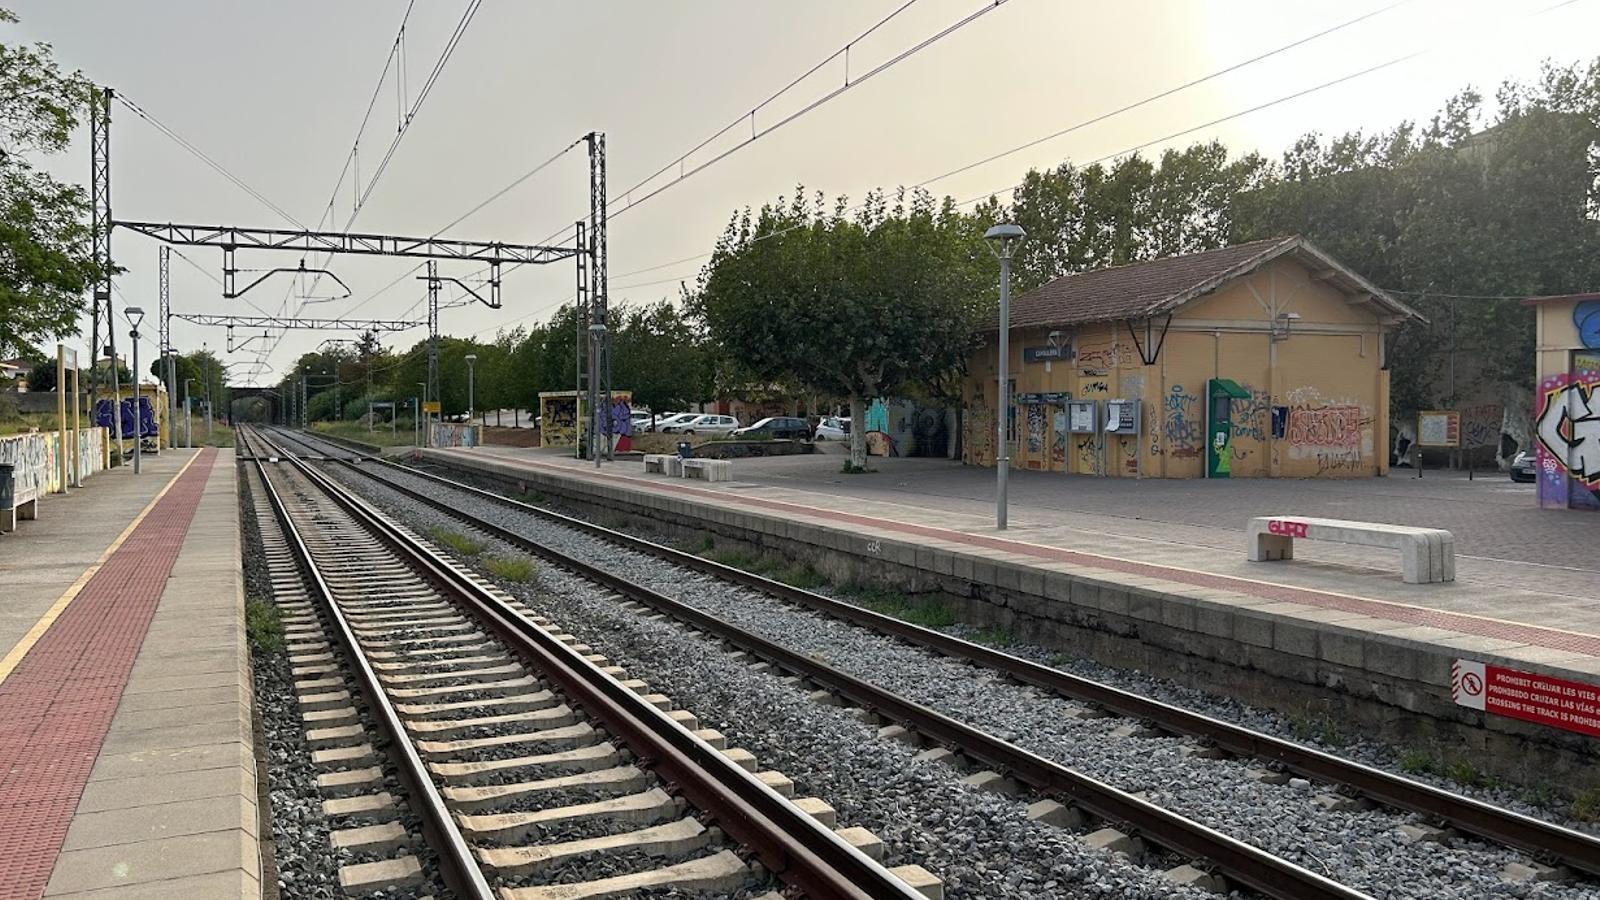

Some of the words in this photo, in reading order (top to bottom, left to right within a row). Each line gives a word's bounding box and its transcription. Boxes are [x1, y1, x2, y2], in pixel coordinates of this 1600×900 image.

[1488, 684, 1529, 699] PROHIBIDO
[1530, 693, 1559, 707] CRUZAR
[1560, 699, 1574, 709] LAS
[1576, 702, 1595, 714] VÍAS
[1496, 674, 1531, 687] PROHIBIT
[1563, 687, 1576, 697] LES
[1577, 690, 1596, 701] VIES
[1487, 696, 1521, 711] CROSSING
[1522, 703, 1536, 714] THE
[1536, 707, 1559, 719] TRACK
[1560, 712, 1568, 721] IS
